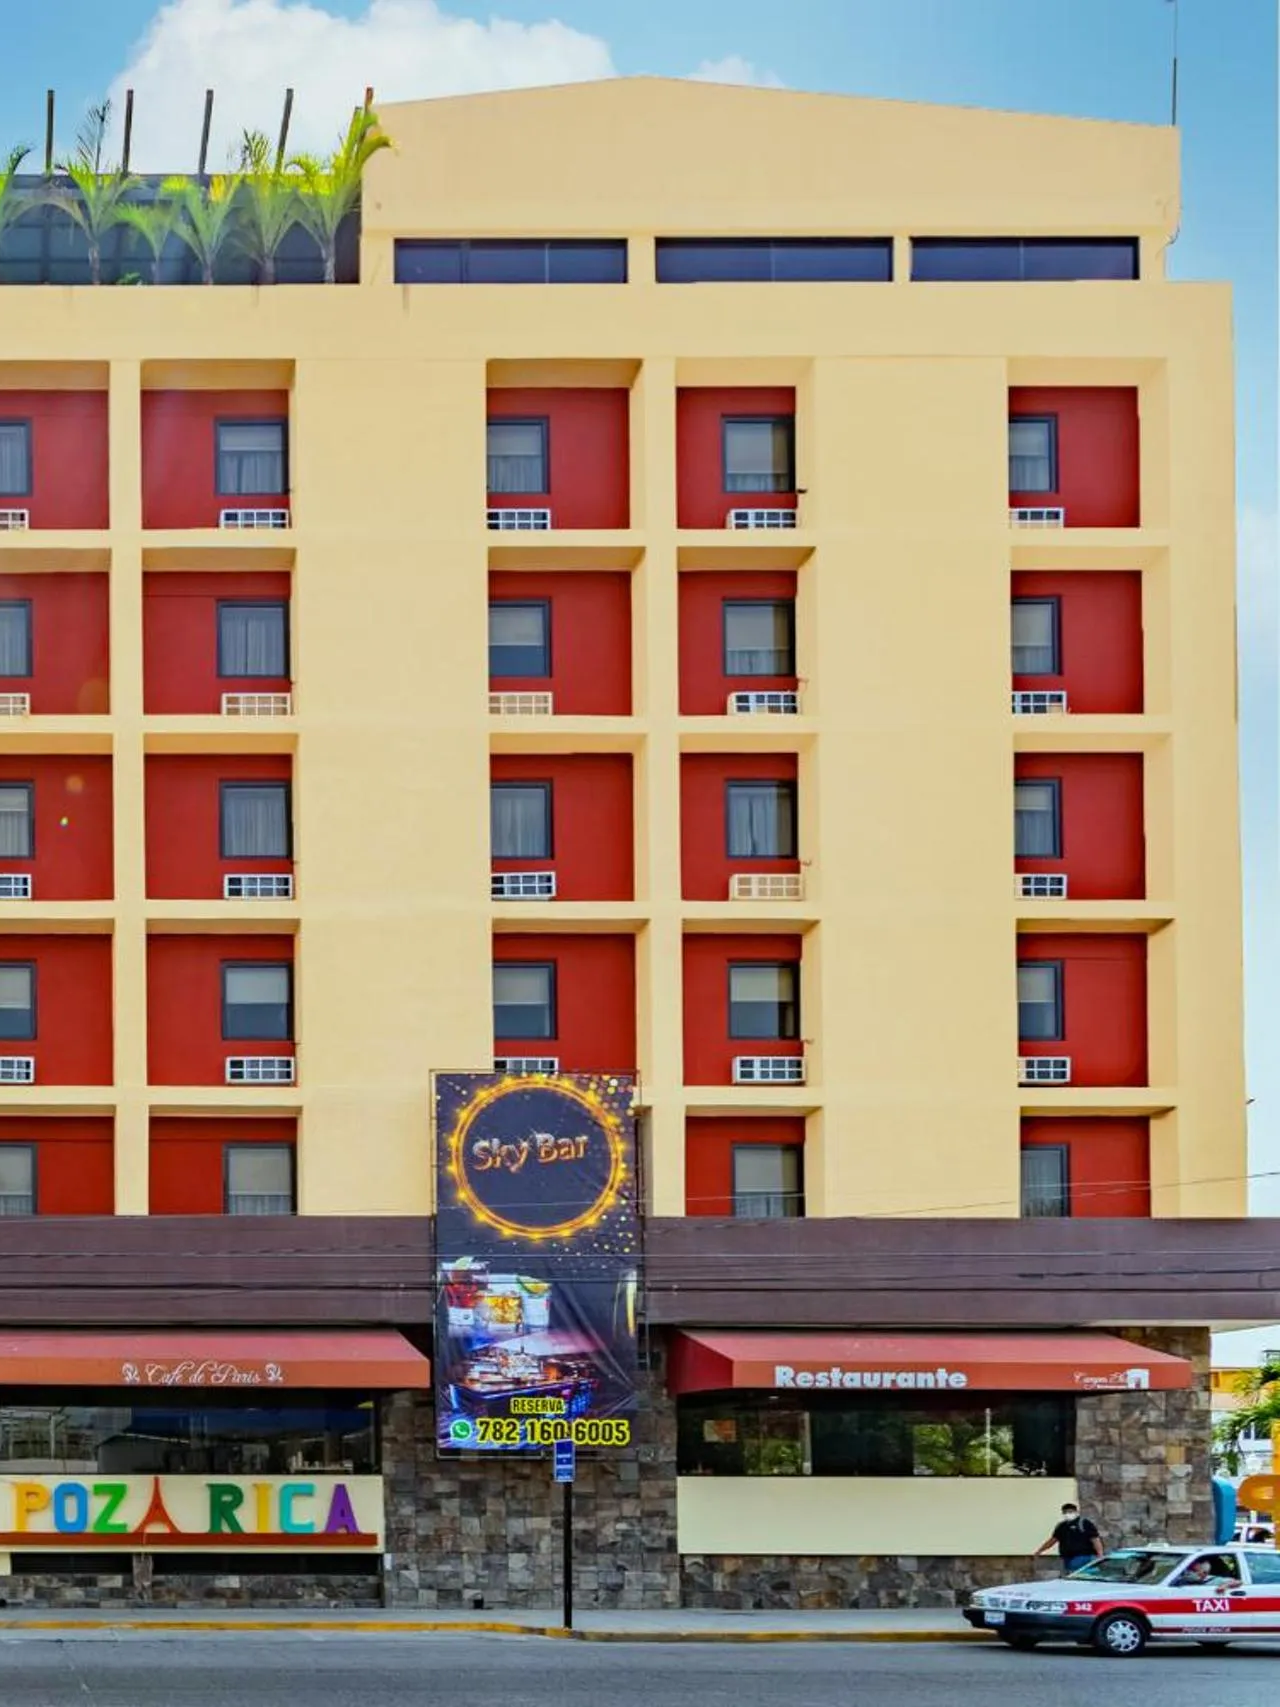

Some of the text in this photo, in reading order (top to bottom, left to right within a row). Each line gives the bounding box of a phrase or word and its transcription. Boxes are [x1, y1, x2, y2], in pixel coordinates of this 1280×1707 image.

[472, 1133, 589, 1173] Sky Bar
[211, 1364, 261, 1384] Paris
[774, 1366, 968, 1388] Restaurante
[512, 1399, 565, 1413] RESERVA
[477, 1420, 629, 1444] 782 160 6005
[206, 1482, 362, 1533] RICA
[1192, 1599, 1230, 1612] TAXI
